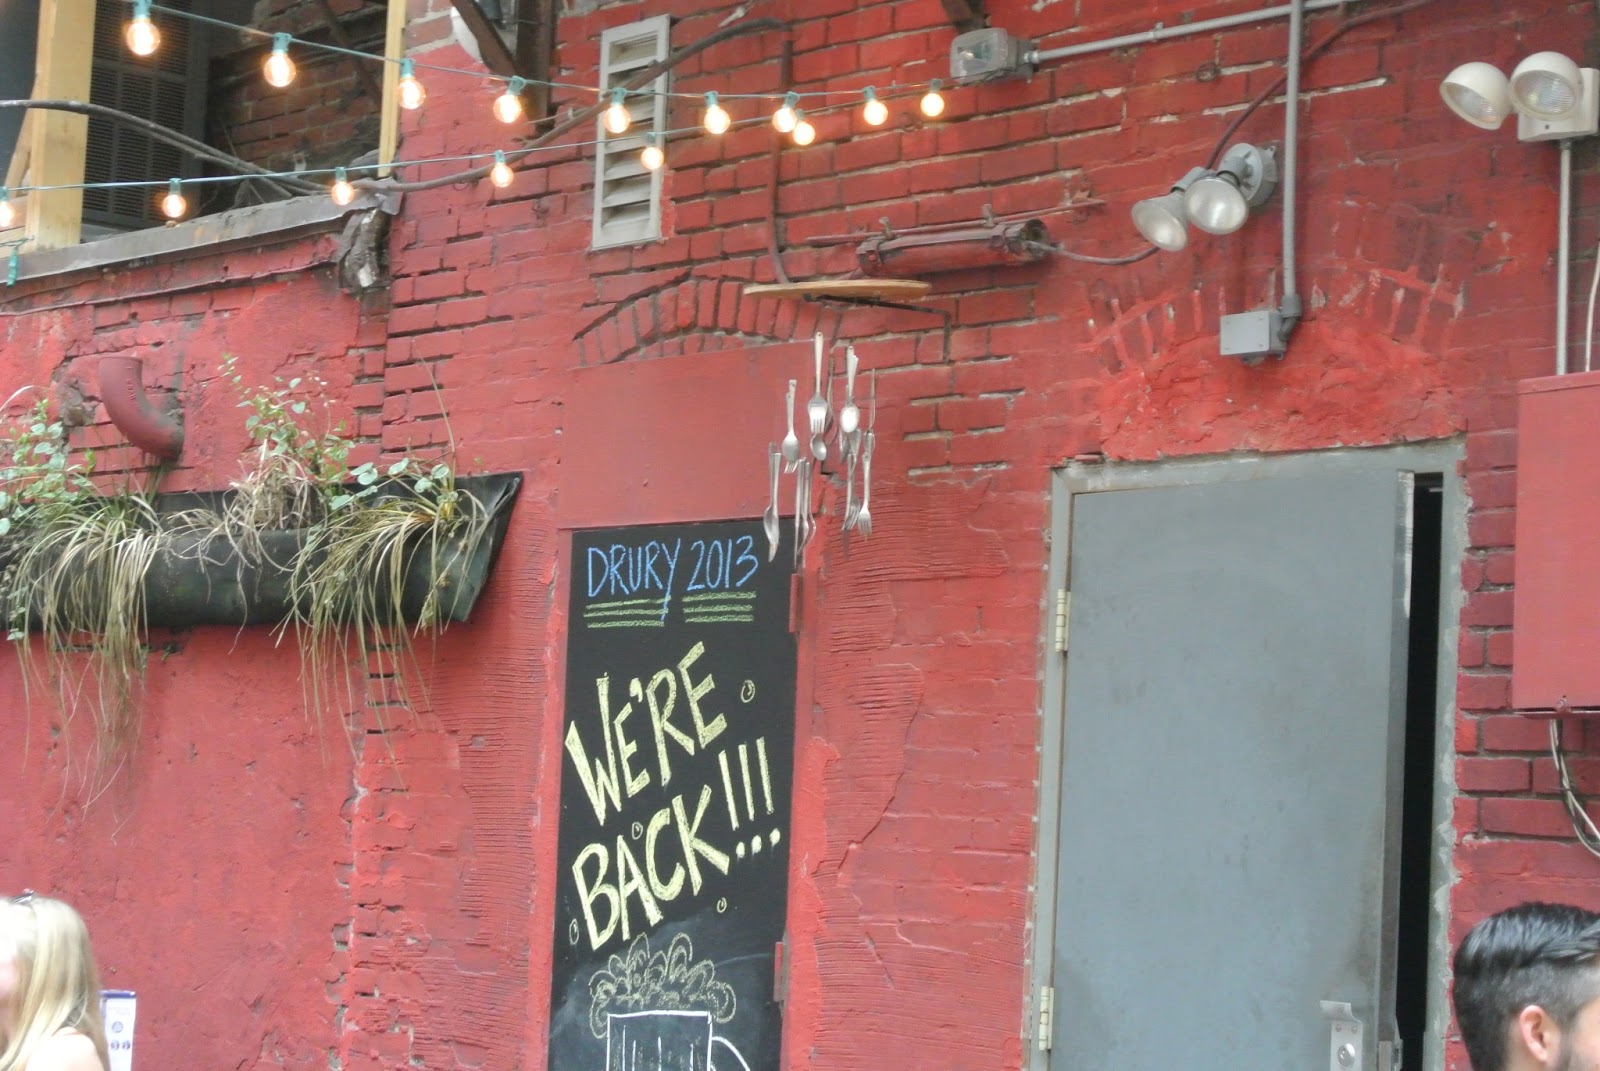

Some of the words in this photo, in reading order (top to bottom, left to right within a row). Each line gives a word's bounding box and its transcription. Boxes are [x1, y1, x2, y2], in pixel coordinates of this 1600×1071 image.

[587, 538, 681, 622] DRURY
[686, 535, 759, 591] 2013
[564, 641, 728, 826] WE'RE
